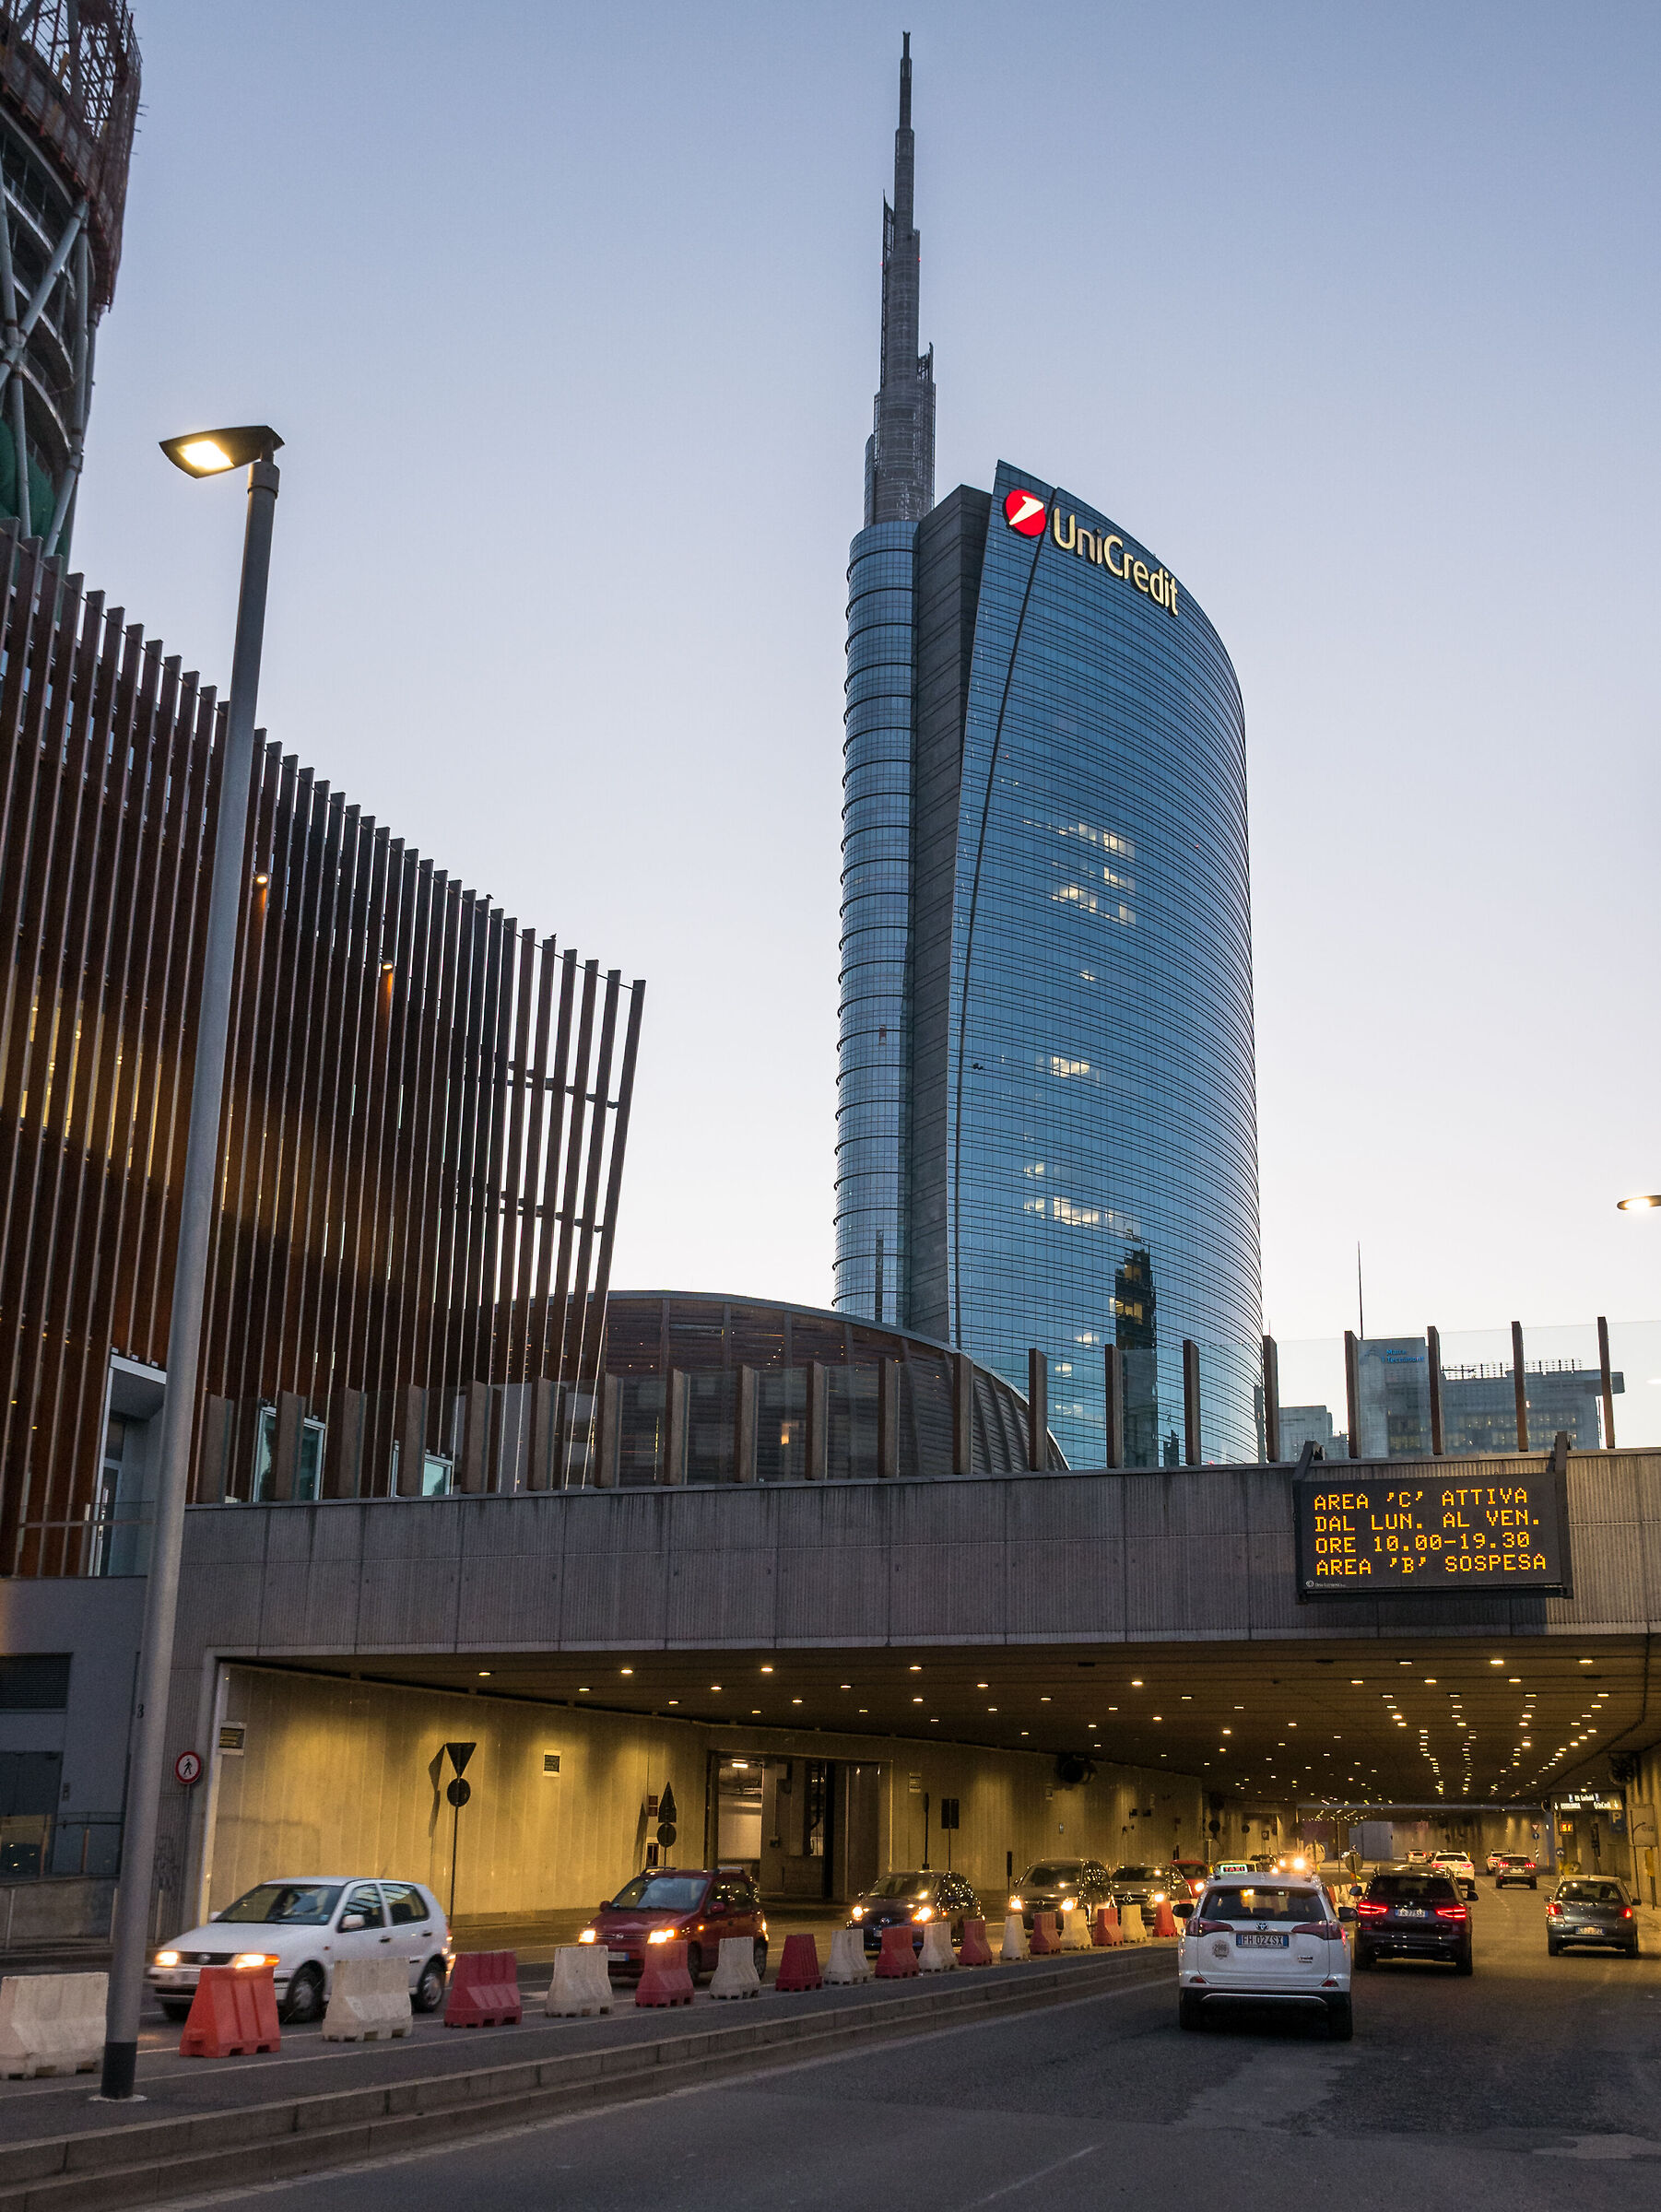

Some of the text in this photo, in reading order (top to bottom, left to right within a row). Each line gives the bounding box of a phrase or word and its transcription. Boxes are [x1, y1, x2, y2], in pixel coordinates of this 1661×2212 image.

[1053, 507, 1179, 617] UniCredit
[1313, 1487, 1527, 1511] AREA 'C' ATTIVA
[1314, 1509, 1539, 1533] DAL LUN. AL VEN.
[1315, 1531, 1530, 1554] ORE 10.00-19.30
[1315, 1552, 1547, 1576] AREA 'B' SOSPESA
[1243, 1936, 1283, 1946] FH 024SX
